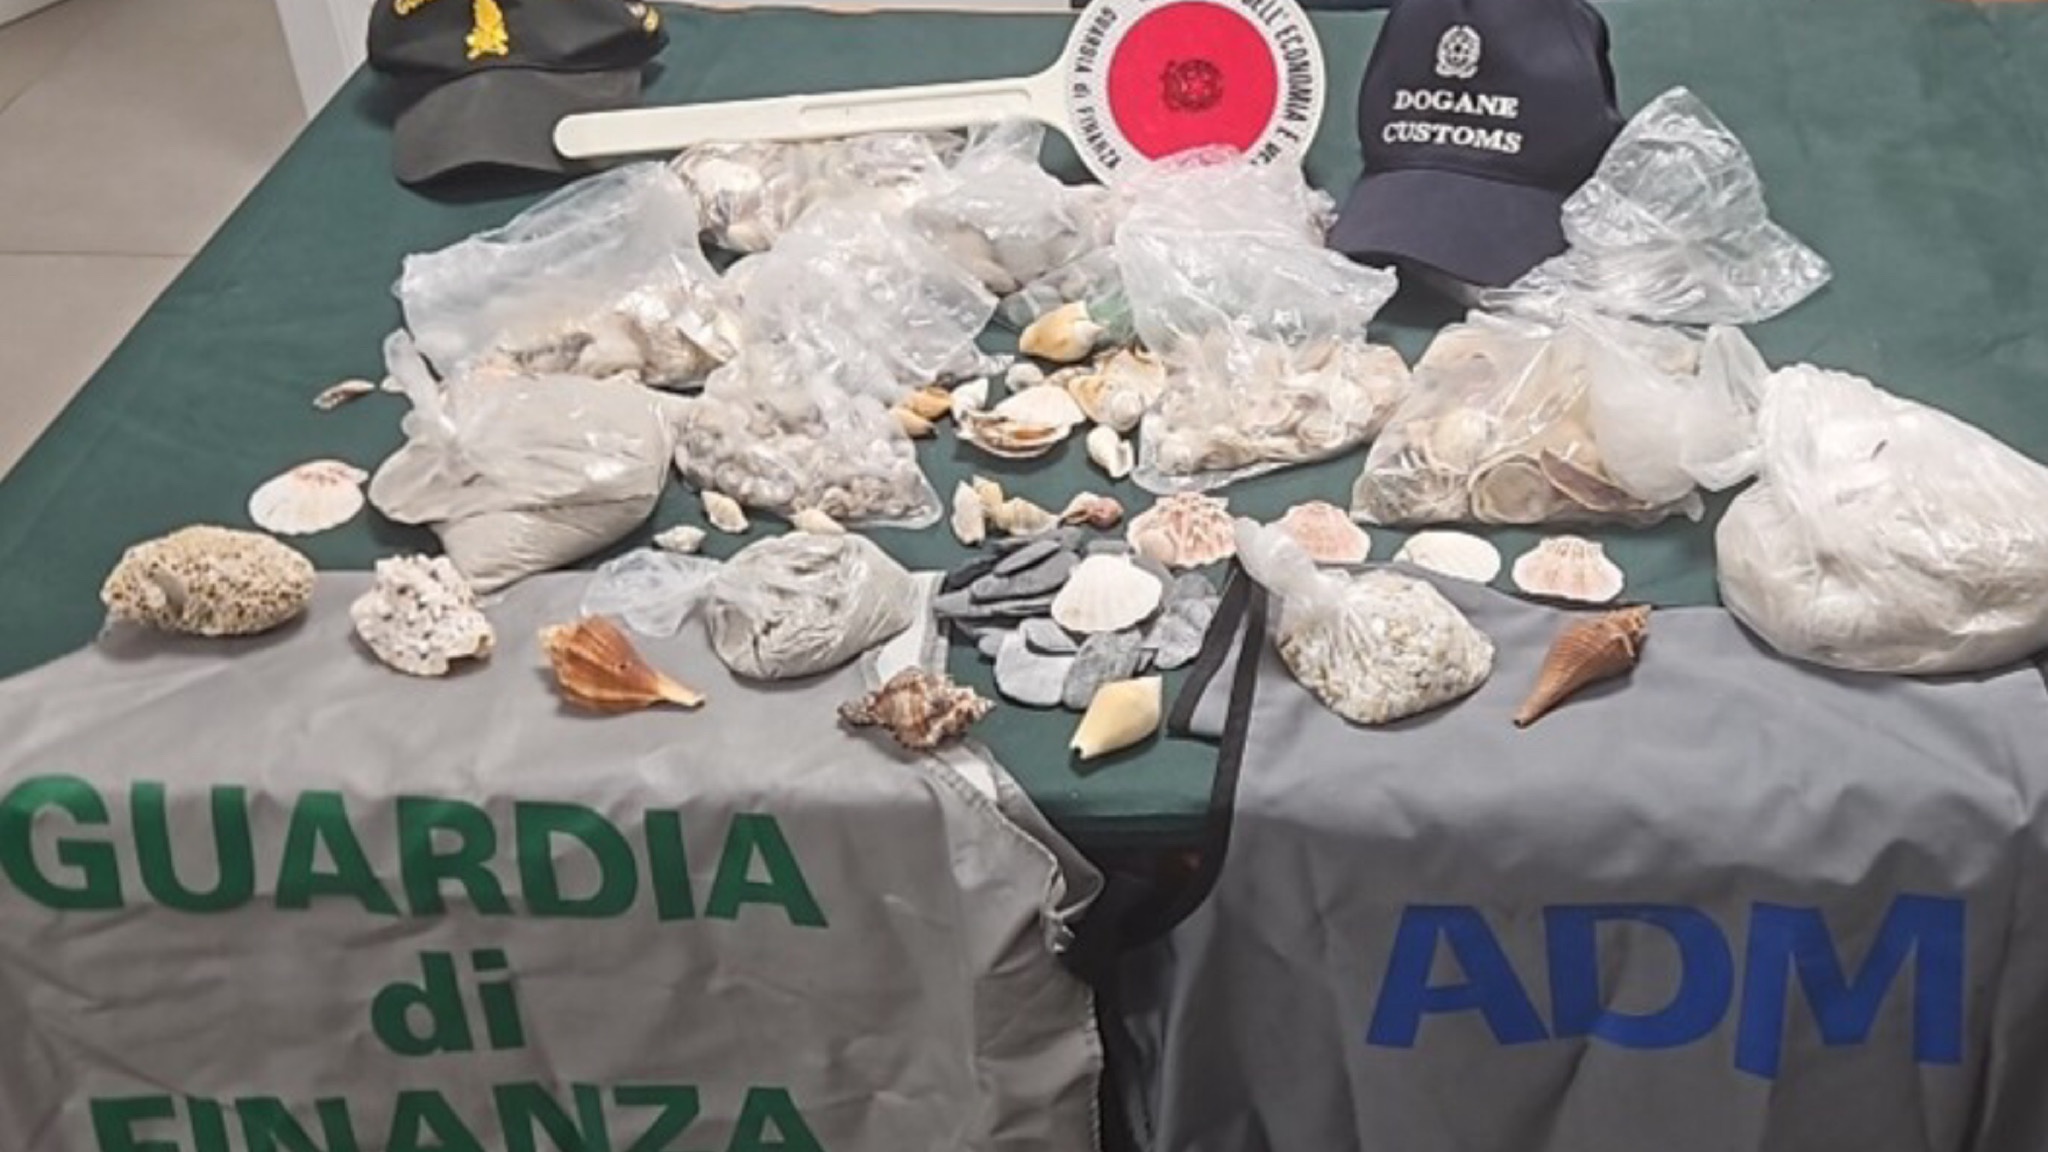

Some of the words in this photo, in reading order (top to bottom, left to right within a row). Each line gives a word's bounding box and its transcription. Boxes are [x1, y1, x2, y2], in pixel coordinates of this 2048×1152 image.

[1074, 6, 1118, 73] GUARDIA
[1275, 25, 1312, 121] ECONOMIA
[1076, 106, 1122, 169] FINANZA
[1276, 126, 1299, 143] E
[1382, 121, 1523, 153] CUSTOMS
[1392, 89, 1519, 119] DOGANE
[0, 774, 829, 928] GUARDIA
[371, 949, 526, 1056] di
[1365, 893, 1967, 1081] ADM
